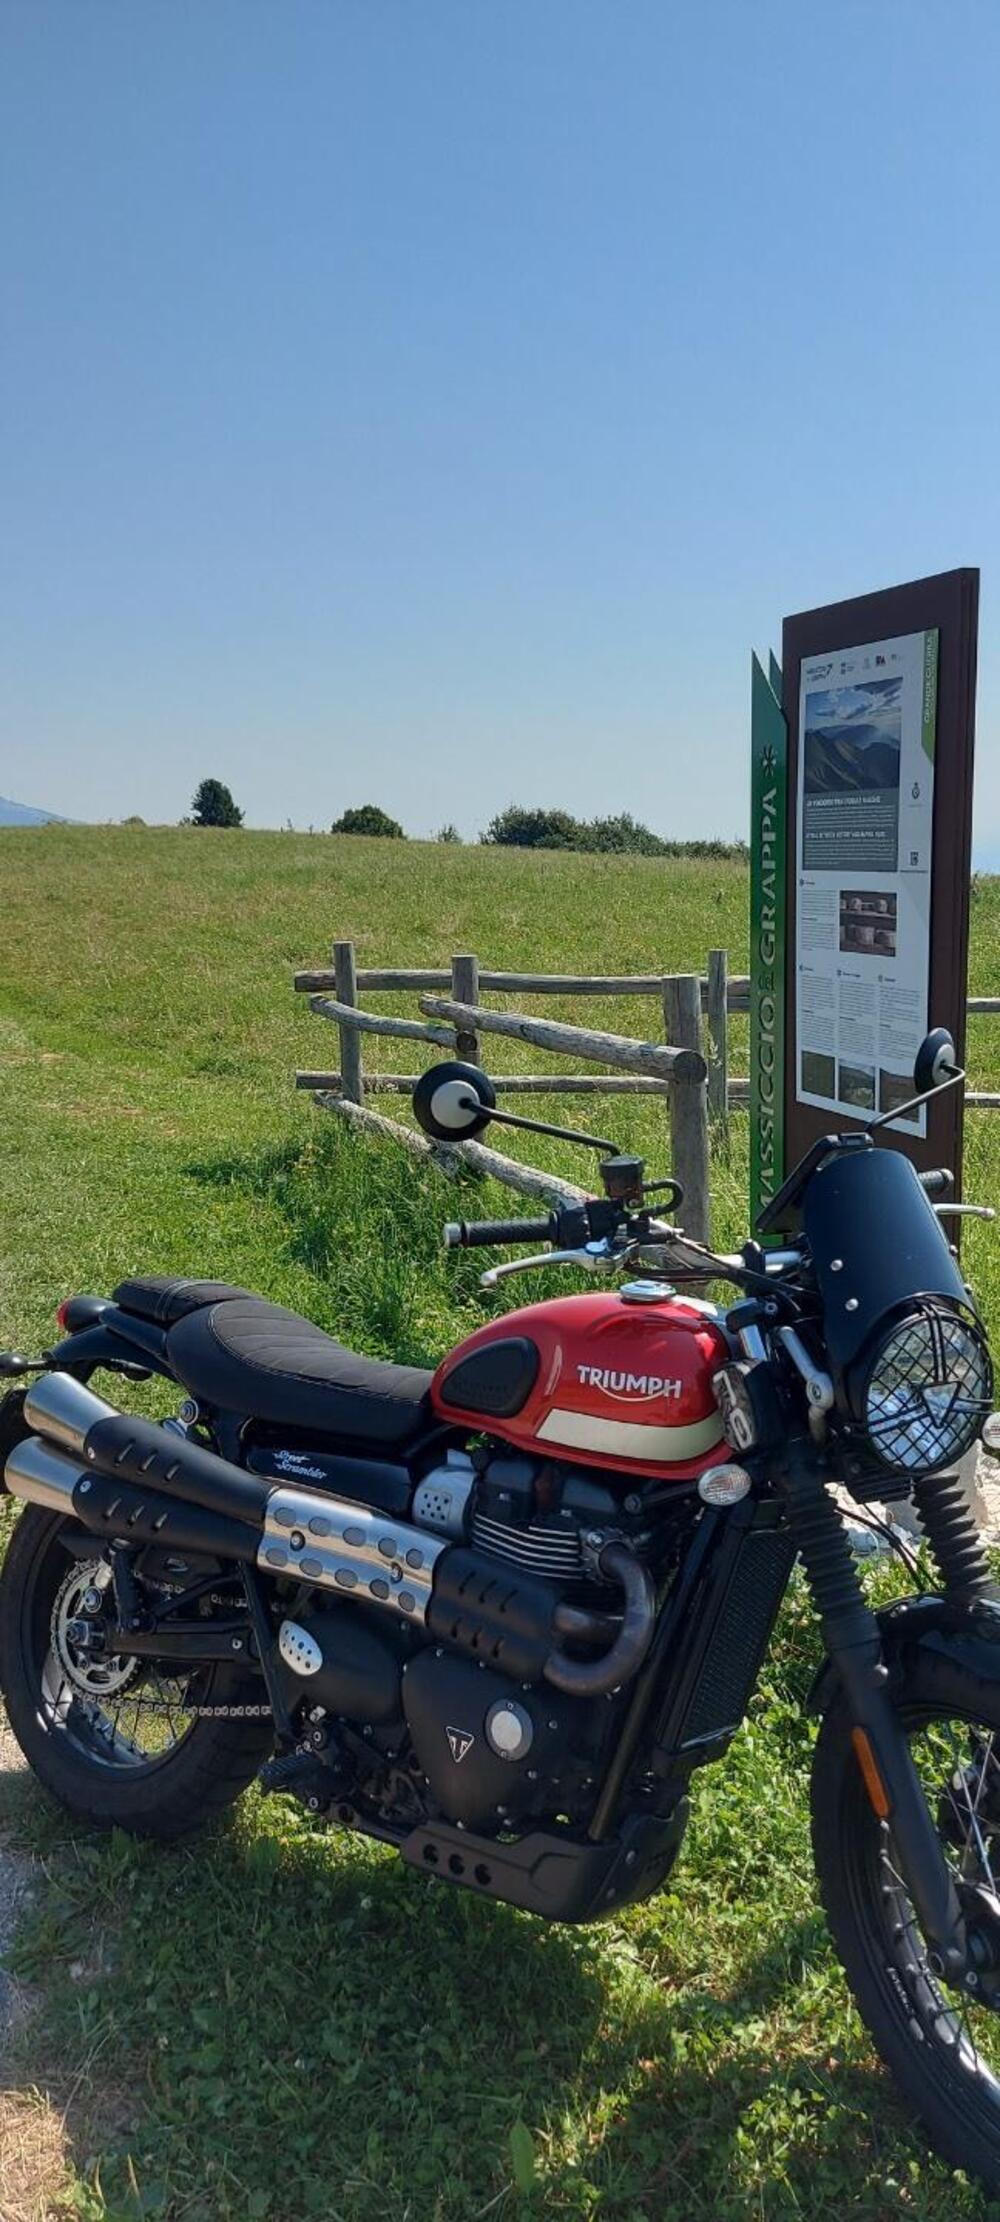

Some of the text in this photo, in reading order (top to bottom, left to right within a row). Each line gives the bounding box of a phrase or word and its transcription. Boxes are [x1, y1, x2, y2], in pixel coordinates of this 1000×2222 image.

[760, 787, 777, 967] GRAPPA
[577, 1364, 683, 1399] TRIUMPH
[273, 1460, 328, 1479] Scrambler
